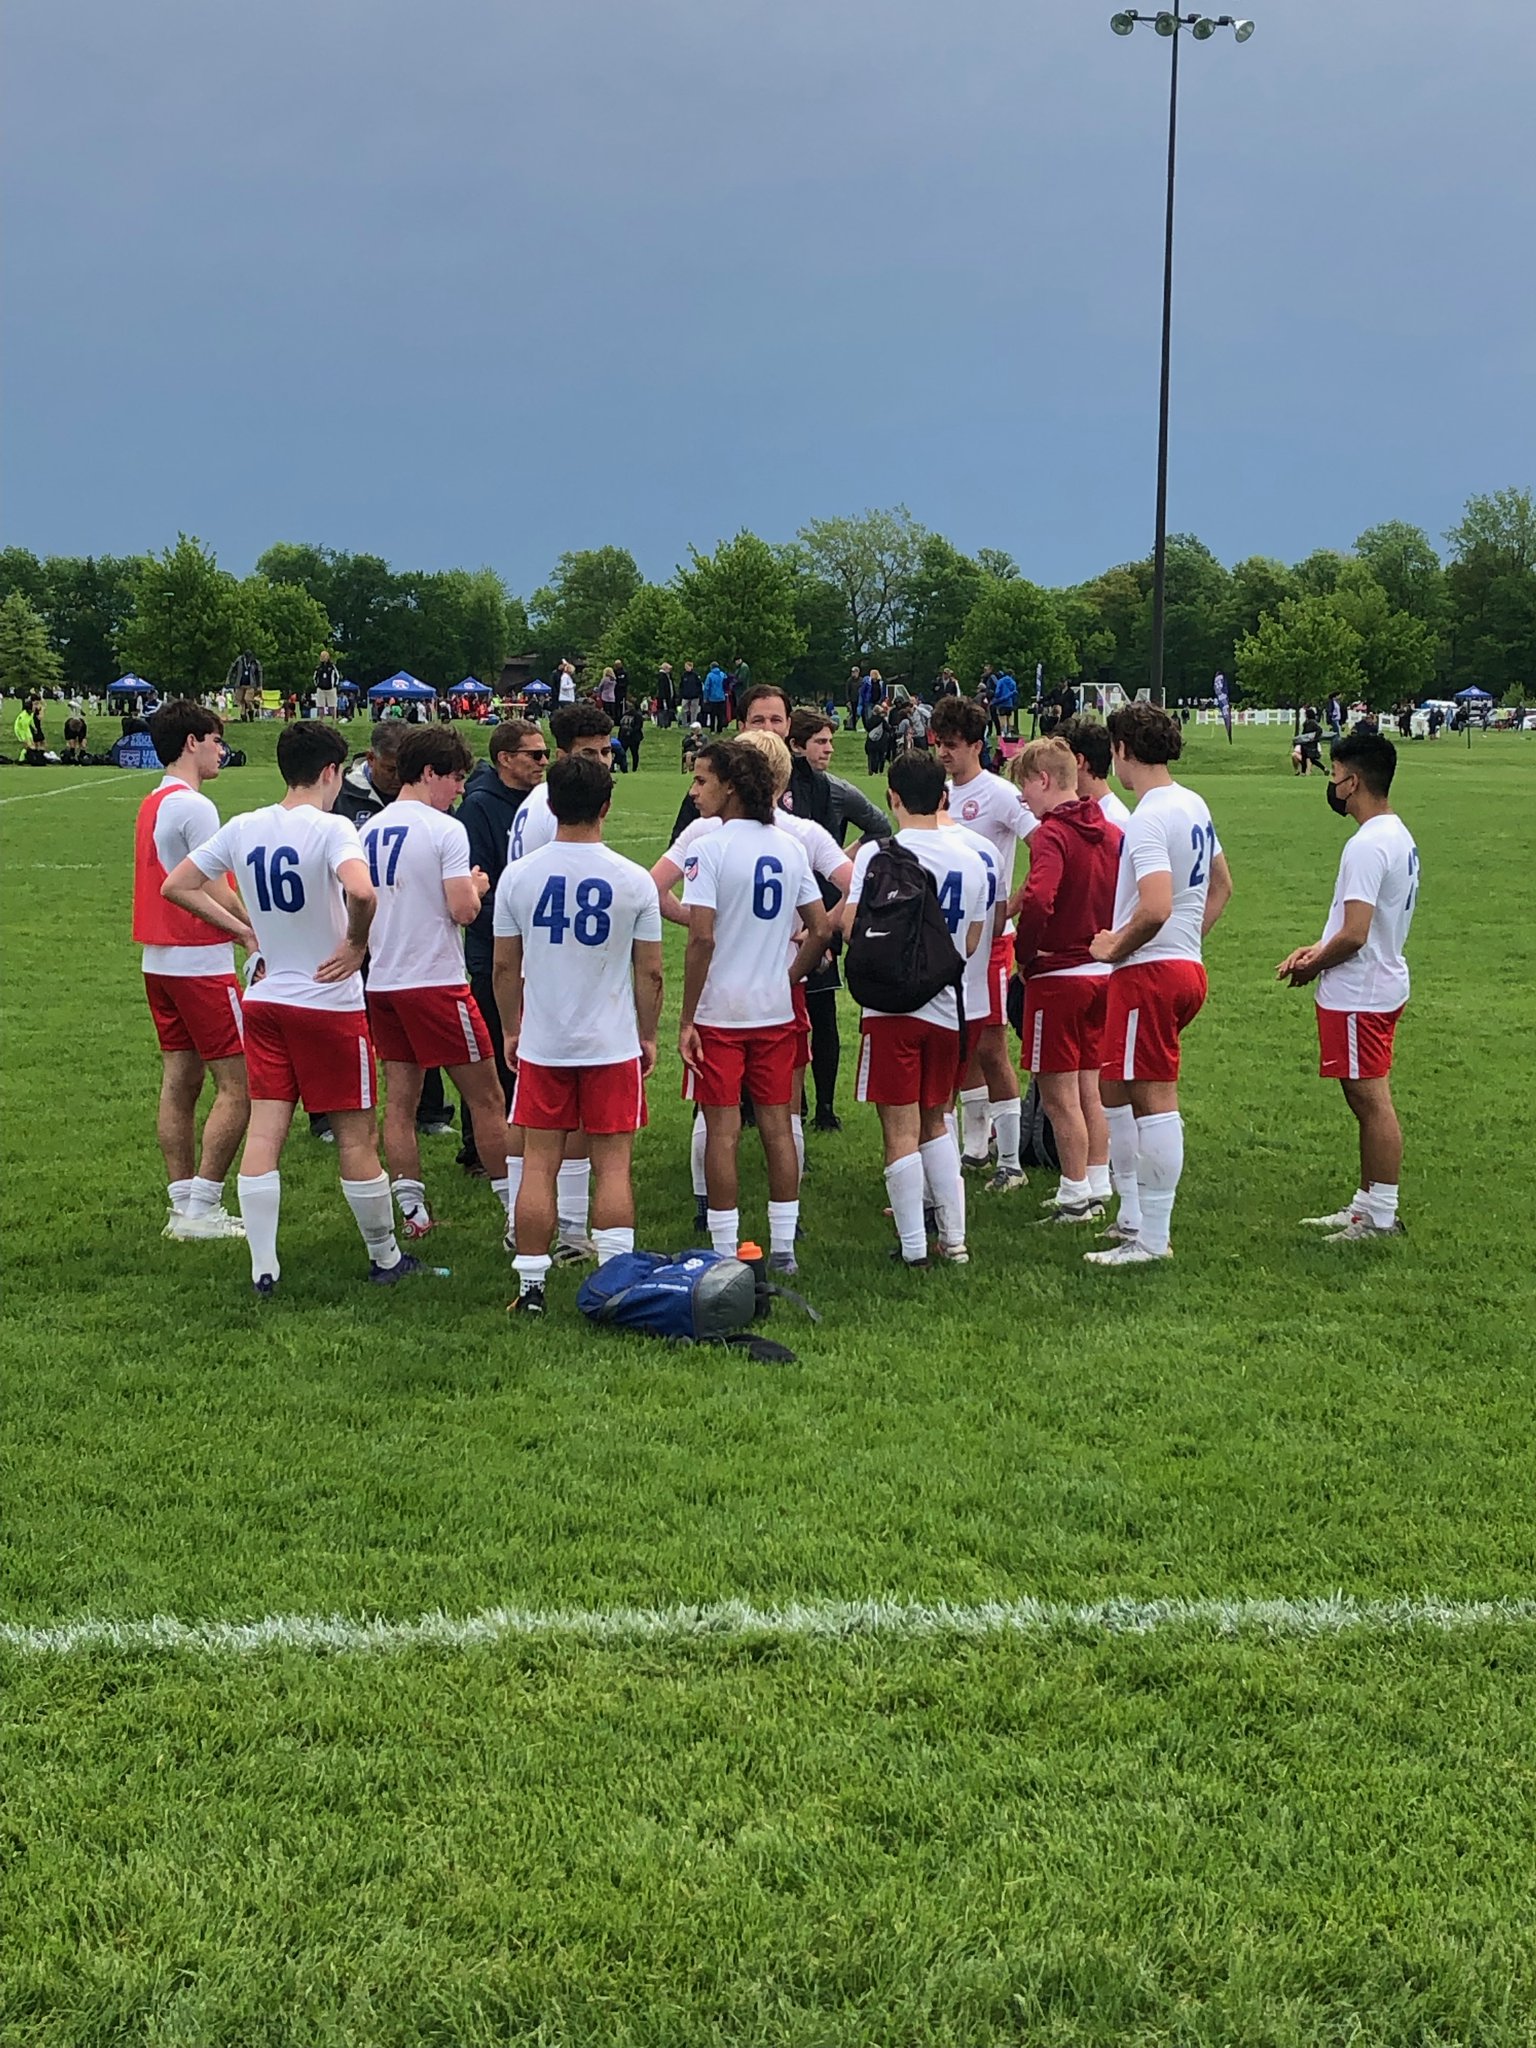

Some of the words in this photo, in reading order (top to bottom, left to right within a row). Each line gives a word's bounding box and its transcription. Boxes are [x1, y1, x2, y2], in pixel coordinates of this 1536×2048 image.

[246, 846, 305, 913] 16
[364, 825, 409, 888] 17
[753, 855, 783, 920] 6
[532, 875, 613, 946] 48
